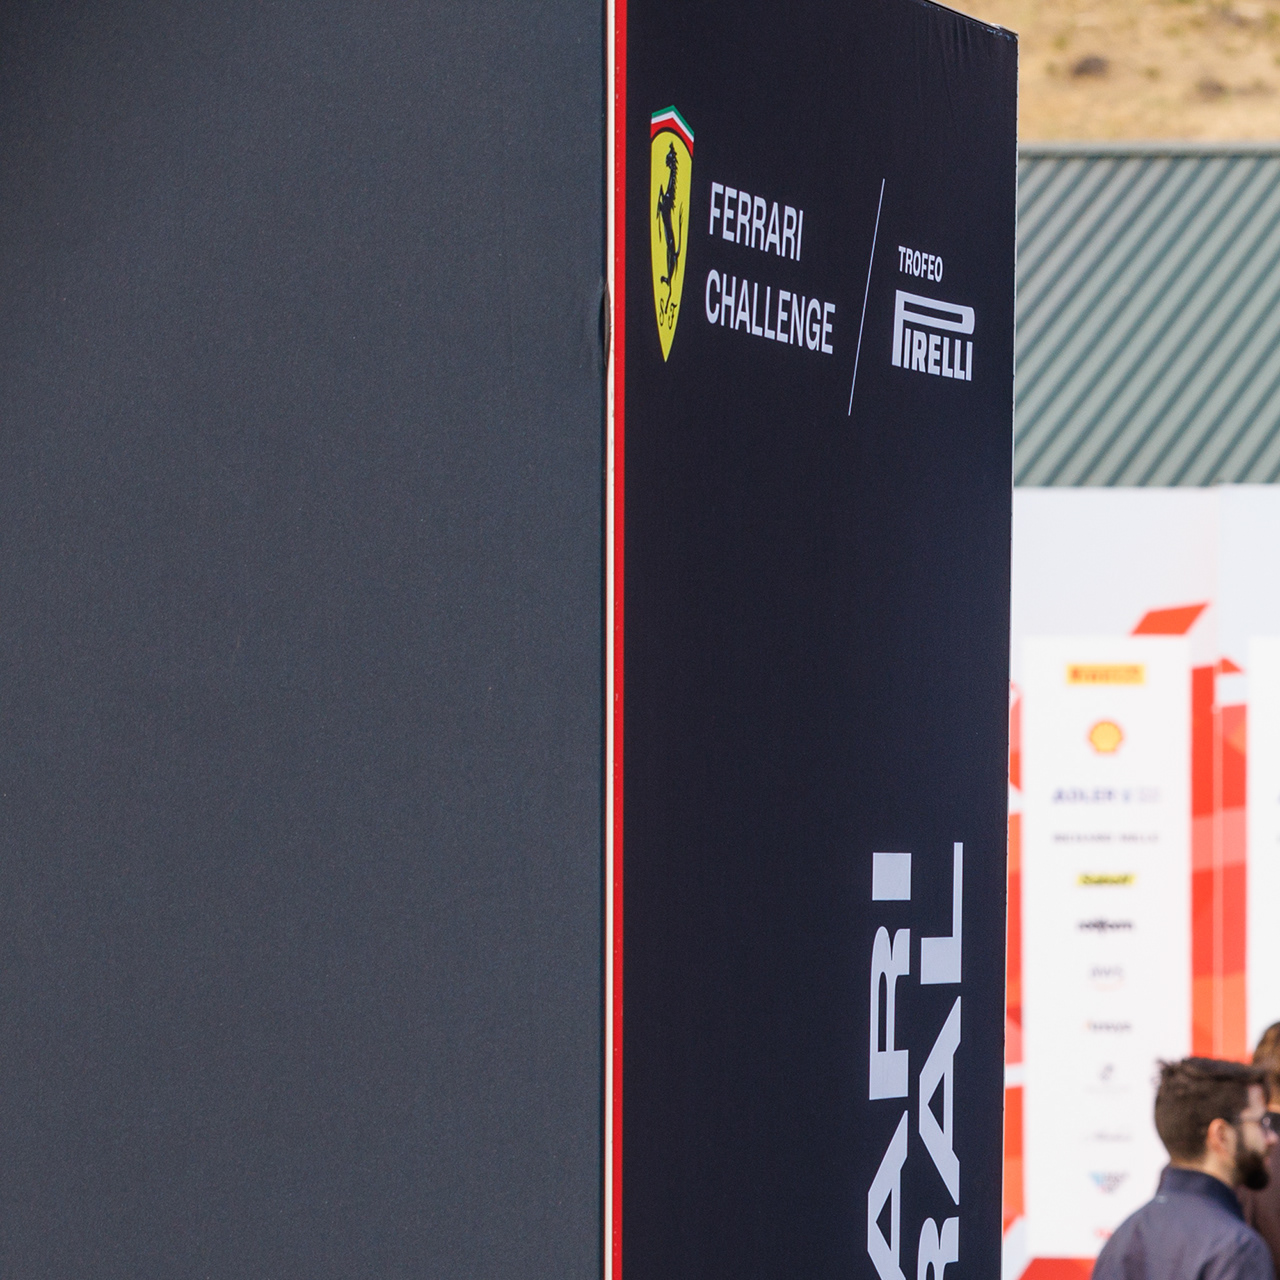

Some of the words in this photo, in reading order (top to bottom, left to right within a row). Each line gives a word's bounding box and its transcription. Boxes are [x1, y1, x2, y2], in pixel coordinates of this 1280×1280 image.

[709, 181, 804, 262] FERRARI
[898, 245, 944, 283] TROFEO
[705, 269, 836, 355] CHALLENGE
[891, 289, 976, 382] PIRELLI
